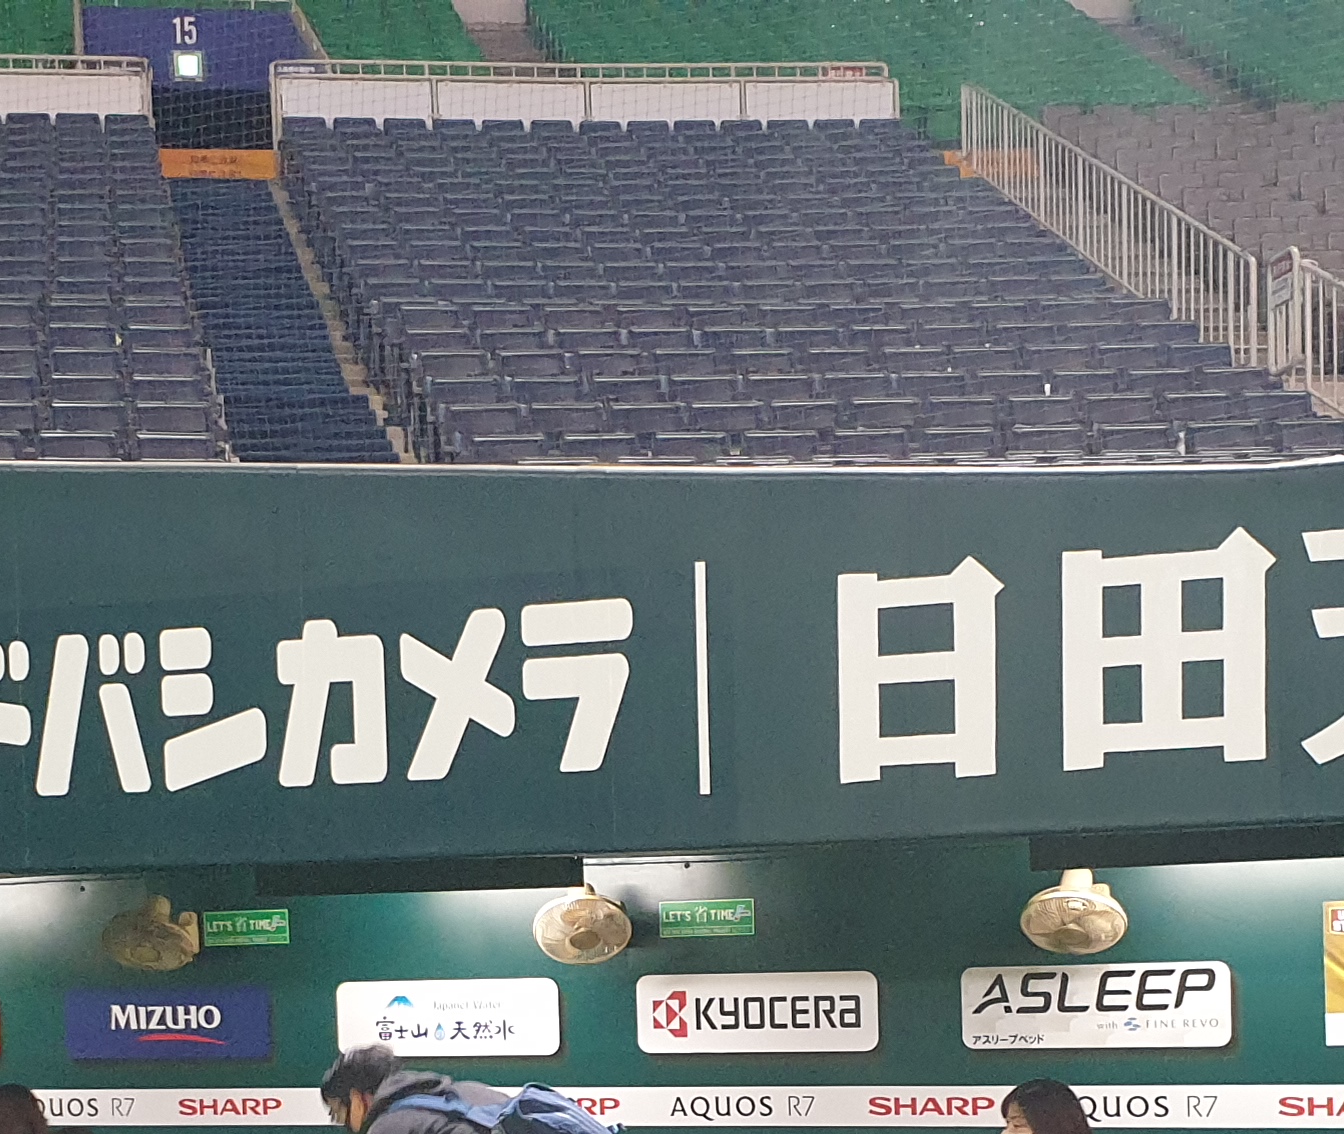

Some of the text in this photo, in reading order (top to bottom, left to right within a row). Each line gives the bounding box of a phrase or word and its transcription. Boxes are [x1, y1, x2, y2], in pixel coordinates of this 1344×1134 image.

[172, 16, 197, 45] 15
[972, 968, 1216, 1014] ASLEEP
[110, 1004, 222, 1031] MIZUHO
[695, 995, 862, 1030] KYOCERA
[1145, 1019, 1177, 1029] FINE
[1183, 1018, 1219, 1029] REVO
[38, 1097, 99, 1118] UOS
[111, 1097, 136, 1117] R7
[178, 1098, 283, 1116] SHARP
[670, 1095, 773, 1121] AQUOS
[787, 1095, 816, 1117] R7
[868, 1096, 996, 1117] SHARP
[1083, 1095, 1170, 1122] QUOS
[1187, 1095, 1218, 1118] R7
